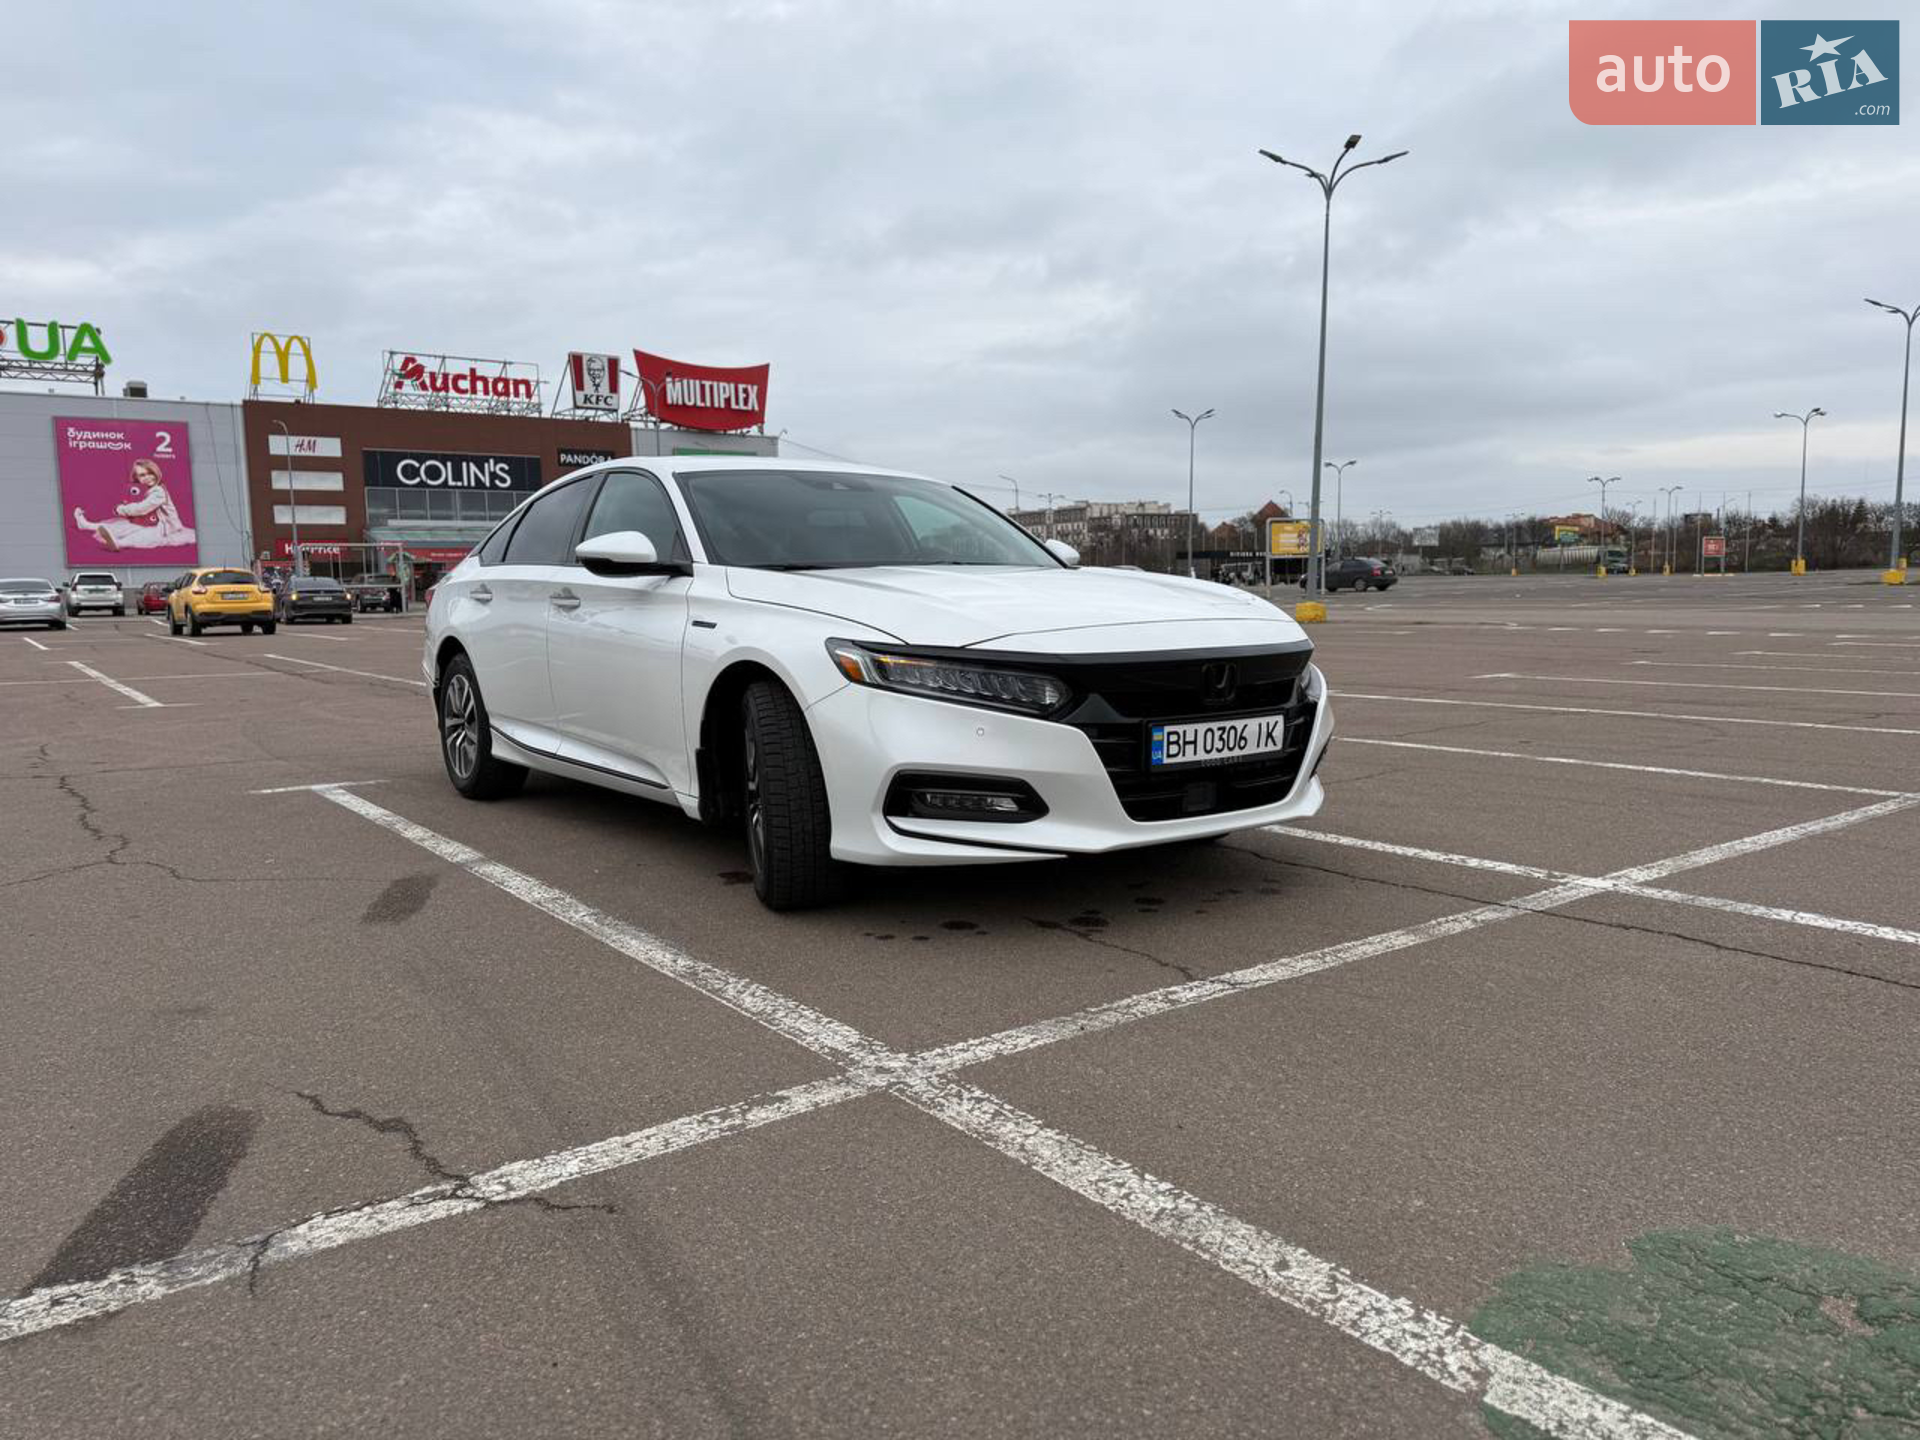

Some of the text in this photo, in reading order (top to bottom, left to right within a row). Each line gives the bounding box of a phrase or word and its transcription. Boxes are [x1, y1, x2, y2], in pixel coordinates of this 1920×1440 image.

[393, 355, 533, 400] Auchan
[665, 376, 760, 412] MULTIPLEX
[582, 393, 613, 407] KFC
[155, 431, 174, 453] 2
[396, 458, 512, 489] COLIN'S
[1166, 719, 1279, 759] BH 0306 IK
